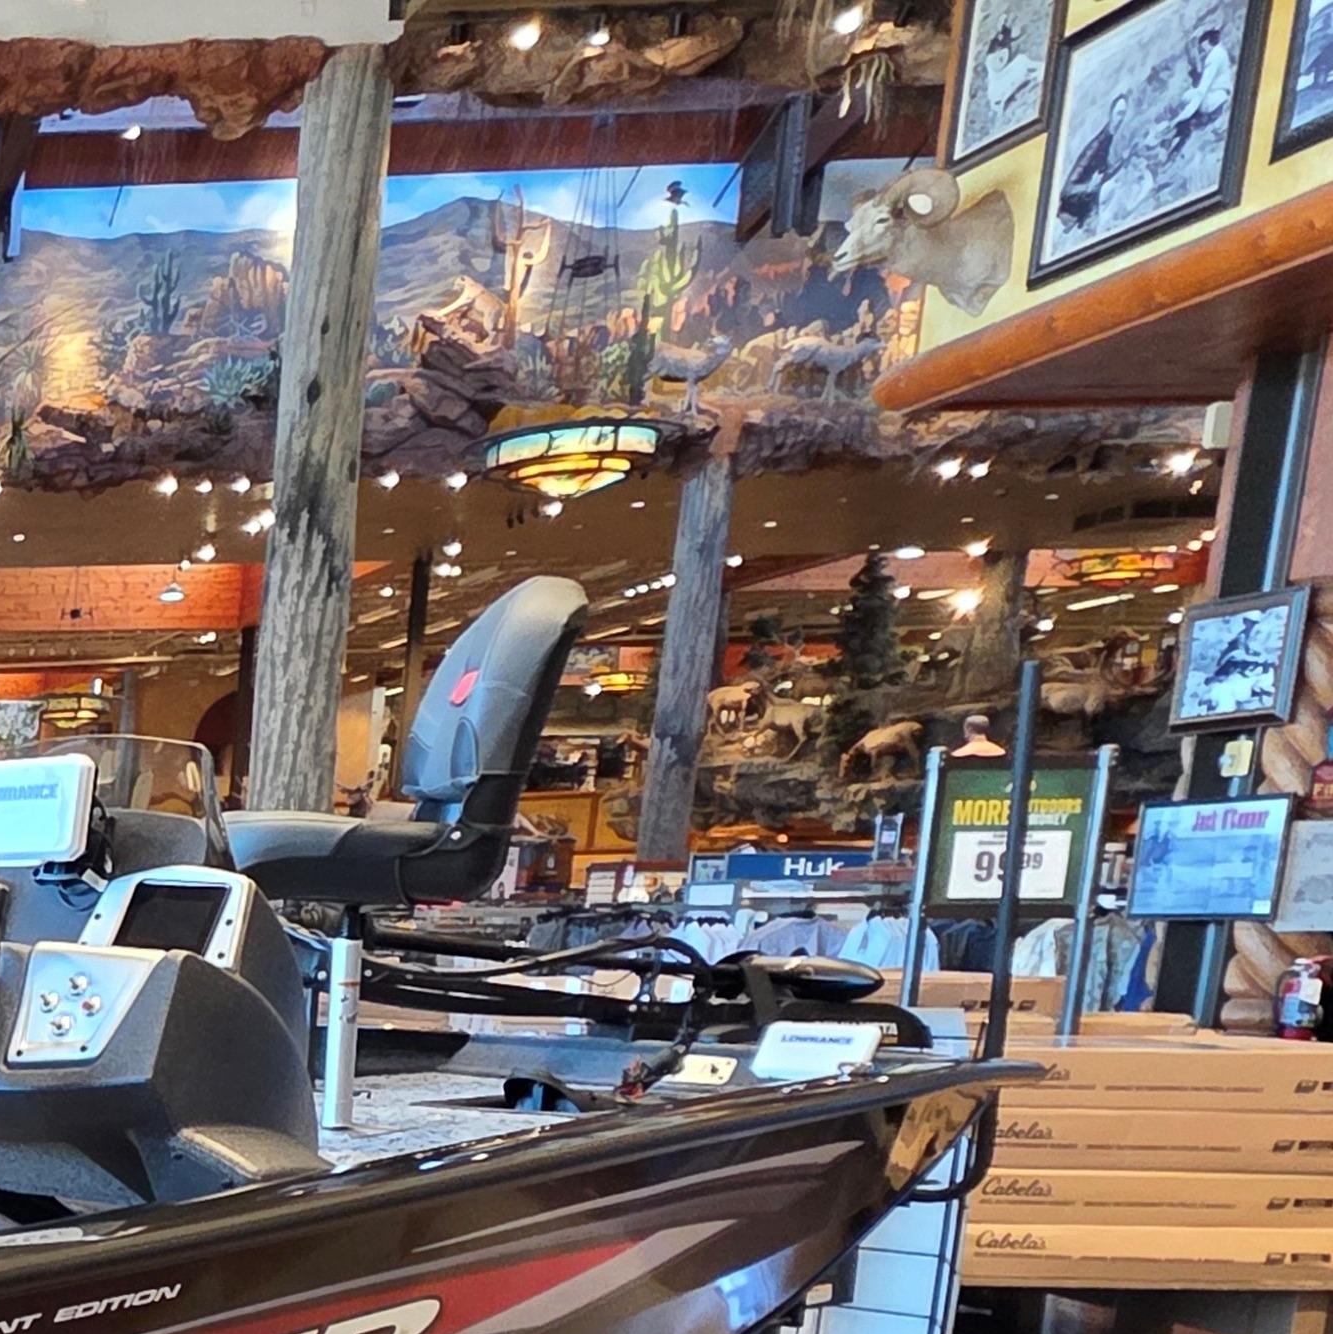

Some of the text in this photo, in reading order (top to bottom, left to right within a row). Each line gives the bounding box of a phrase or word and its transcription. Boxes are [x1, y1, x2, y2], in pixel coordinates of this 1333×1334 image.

[952, 799, 1011, 826] MORE
[784, 856, 845, 877] Huk
[53, 1284, 182, 1324] EDITION
